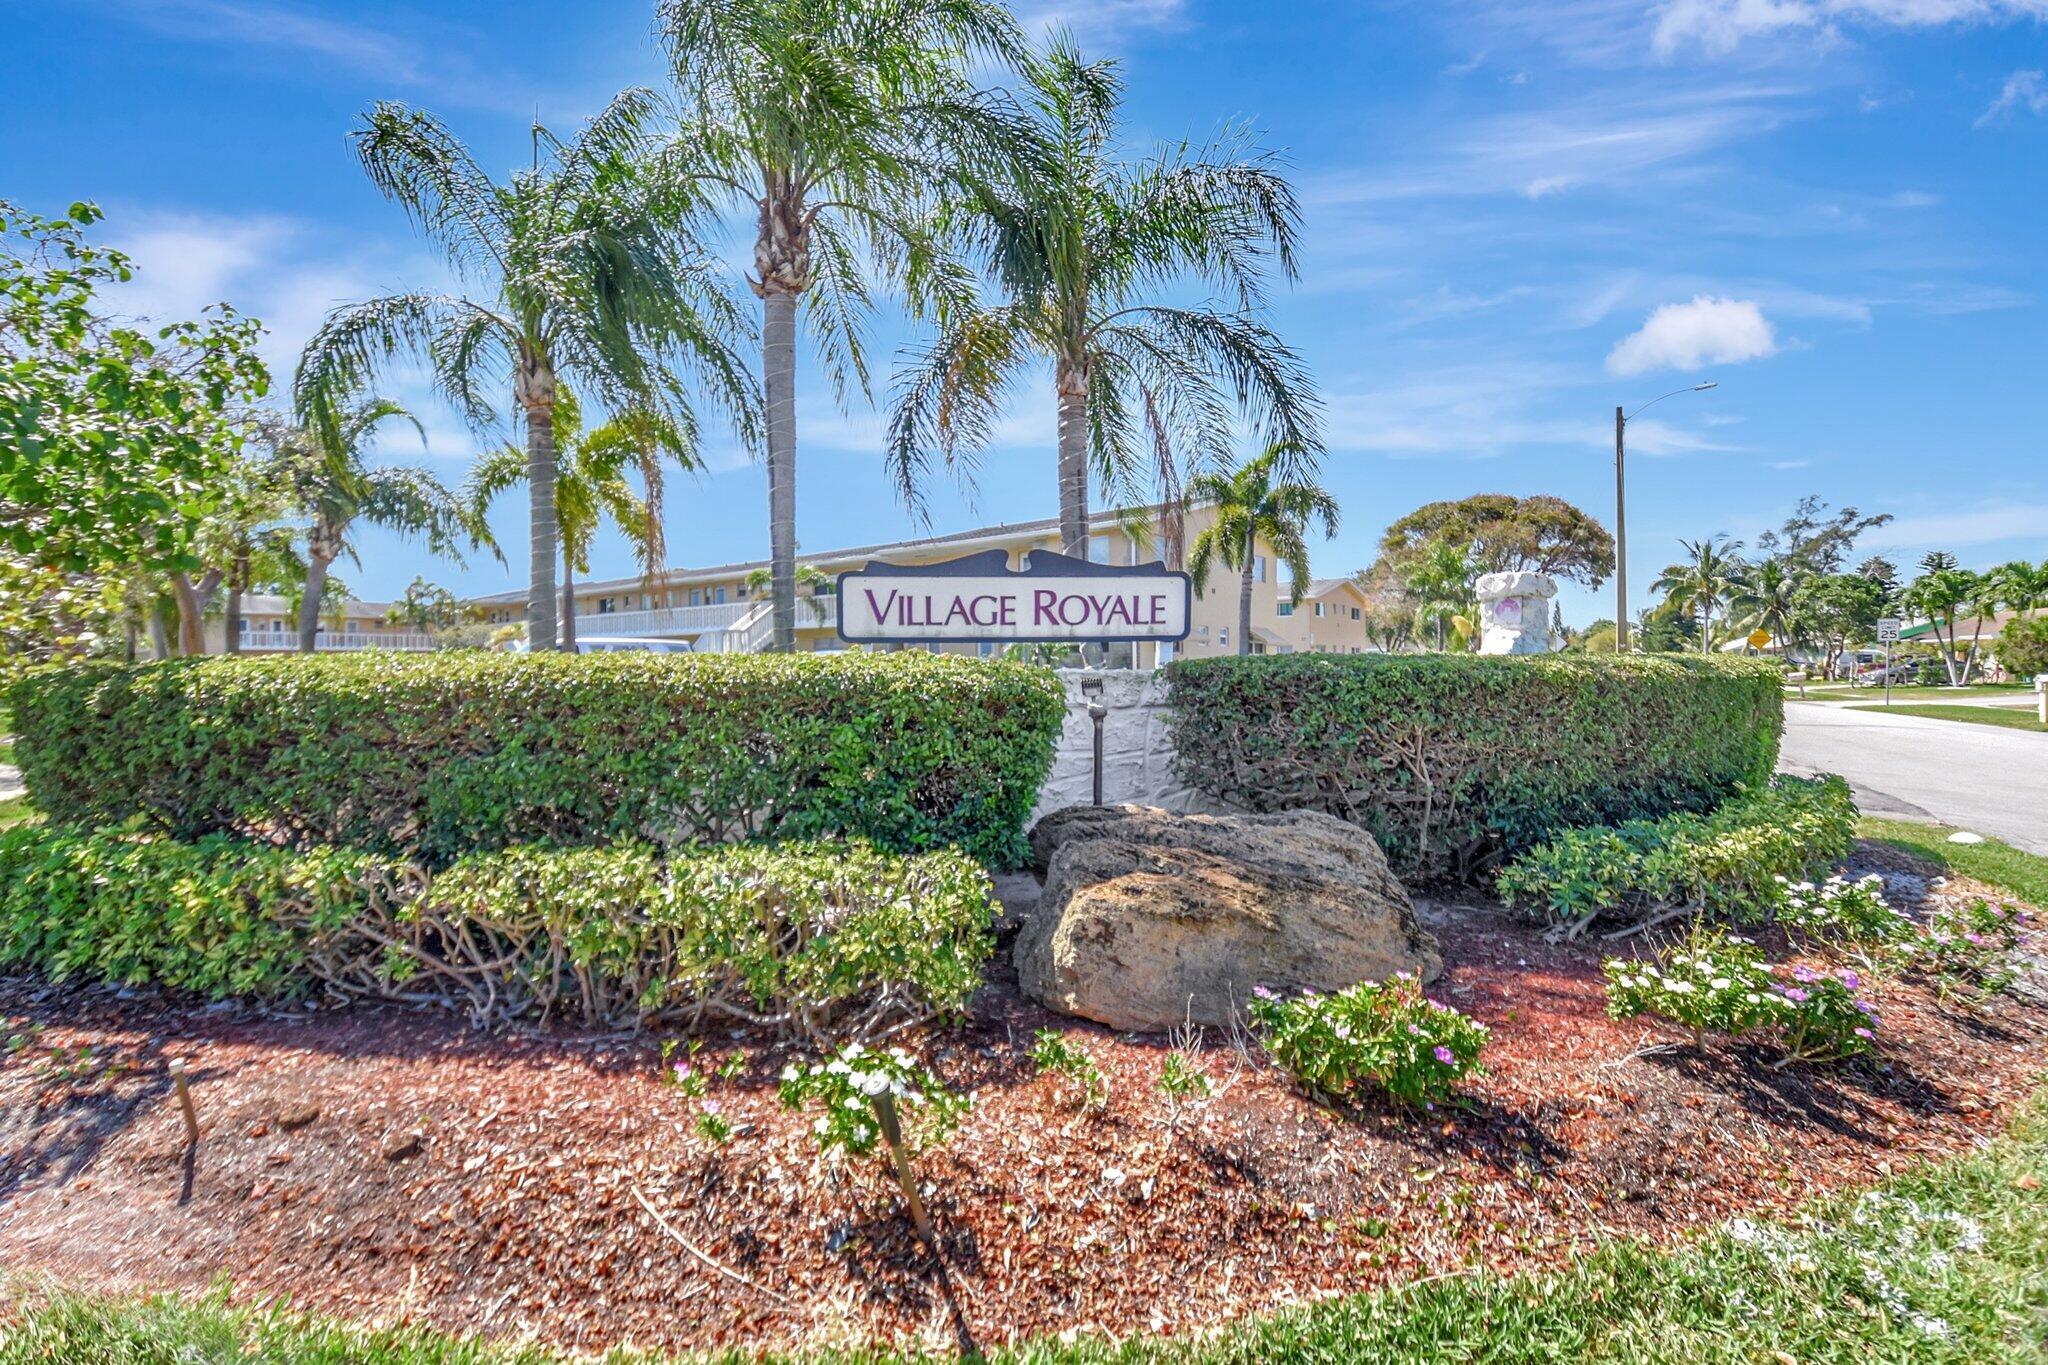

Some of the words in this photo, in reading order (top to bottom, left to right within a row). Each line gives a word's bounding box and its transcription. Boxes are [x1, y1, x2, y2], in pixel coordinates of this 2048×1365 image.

[864, 588, 1017, 627] VILLAGE
[1033, 588, 1167, 627] ROYALE
[1881, 630, 1897, 639] 25
